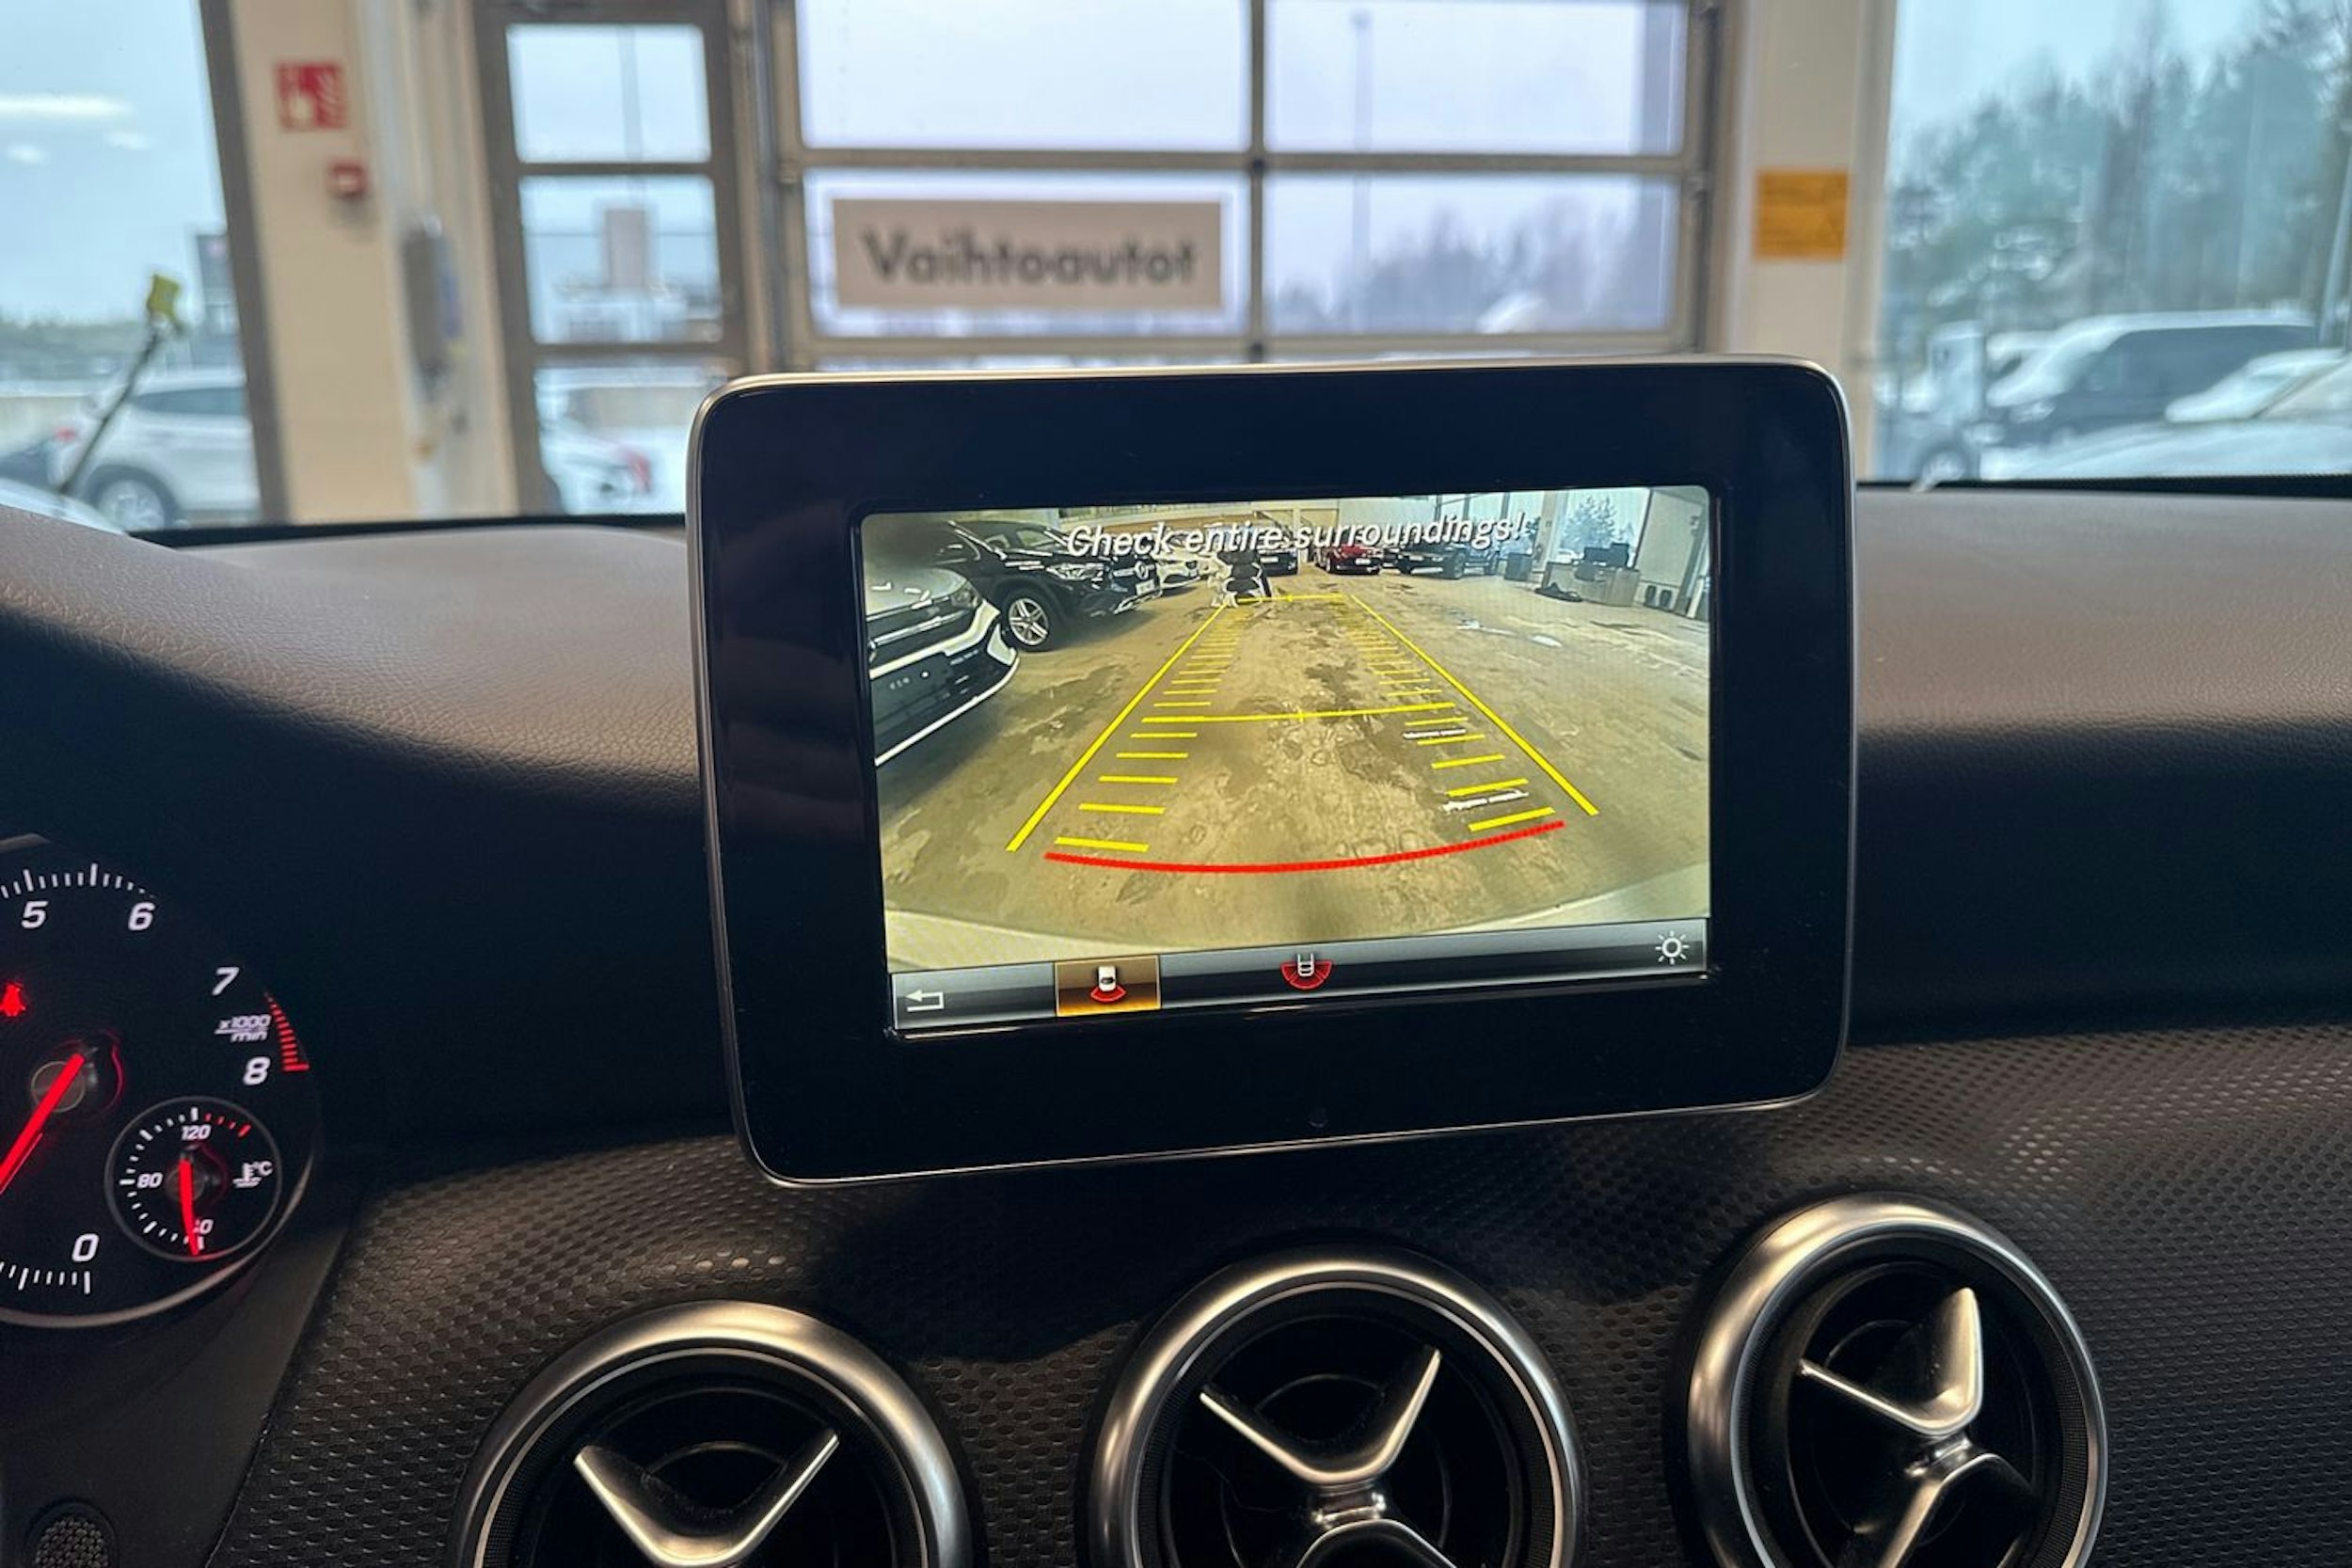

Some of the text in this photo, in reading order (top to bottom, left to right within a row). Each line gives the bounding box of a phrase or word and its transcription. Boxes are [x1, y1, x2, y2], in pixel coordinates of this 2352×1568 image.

[861, 226, 1197, 284] Vaihtoautot
[1067, 512, 1526, 557] Check entire surroundings!
[22, 900, 48, 929] 5
[128, 901, 155, 930] 6
[212, 967, 239, 996] 7
[243, 1056, 271, 1085] 8
[182, 1124, 212, 1141] 120
[136, 1172, 163, 1189] 80
[72, 1232, 100, 1262] 0
